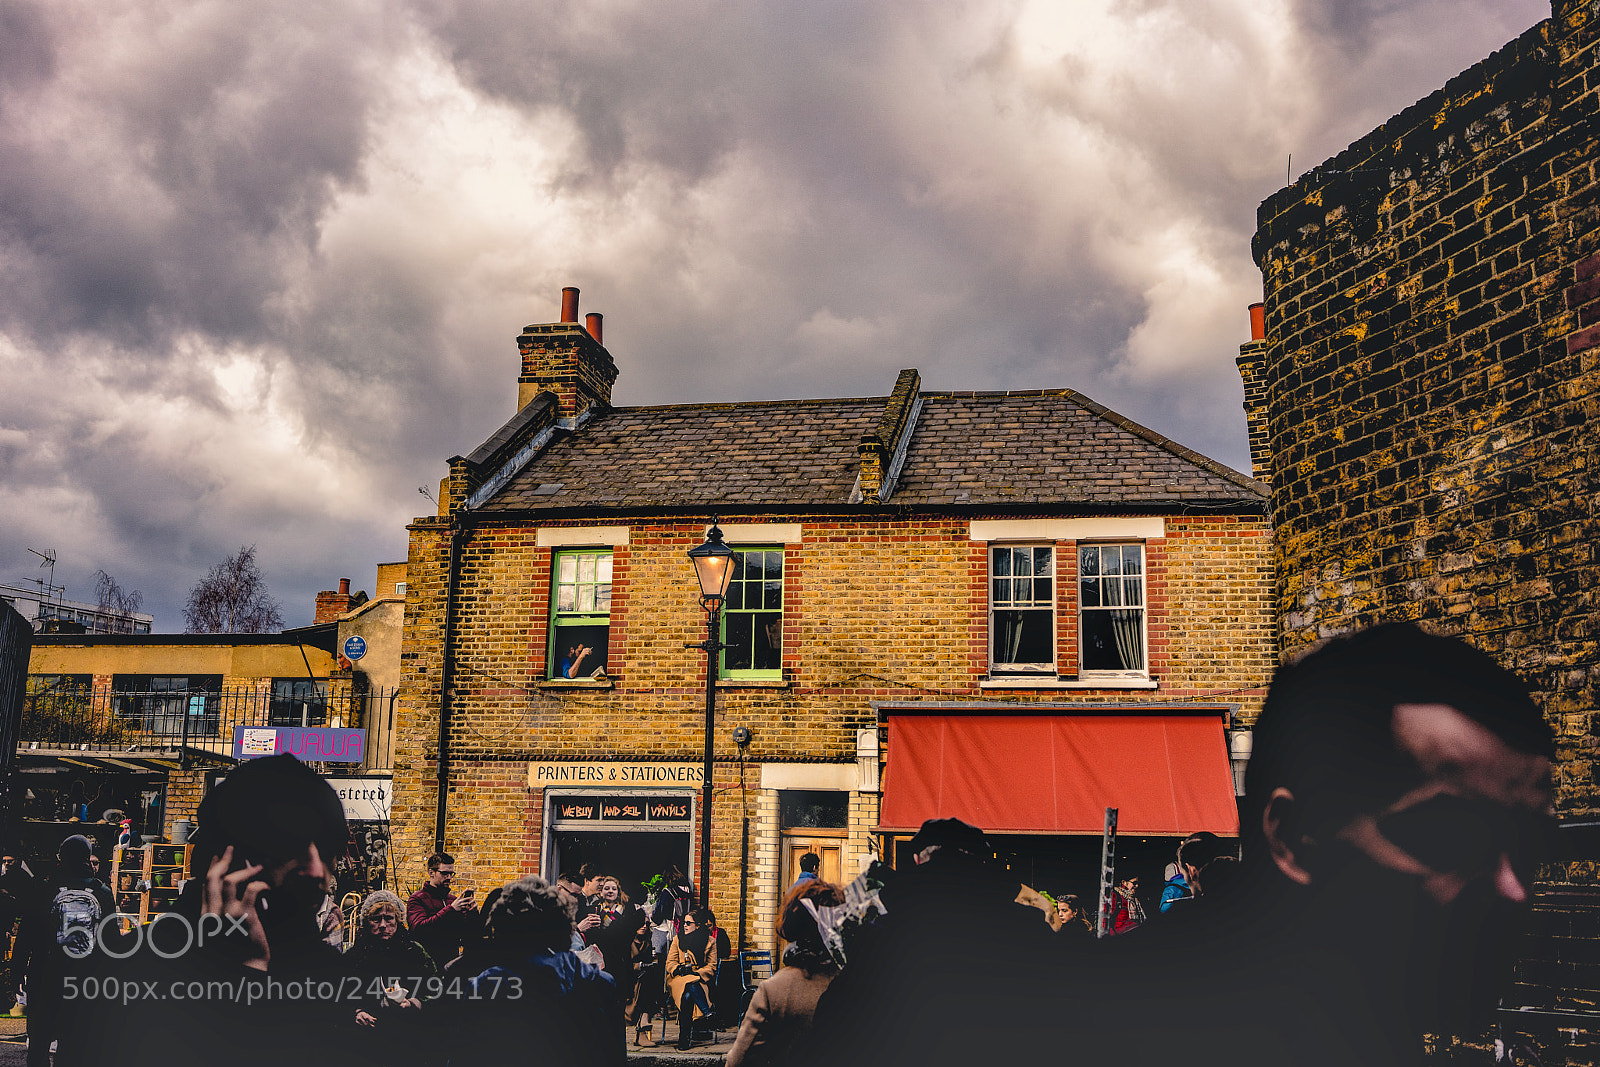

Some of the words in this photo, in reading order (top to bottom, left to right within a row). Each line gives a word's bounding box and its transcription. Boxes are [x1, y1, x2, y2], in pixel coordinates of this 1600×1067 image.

[280, 732, 362, 757] WAWA
[537, 766, 604, 780] PRINTERS
[608, 766, 618, 780] &
[621, 766, 704, 781] STATIONERS
[339, 787, 385, 800] stered
[562, 804, 575, 818] WE
[576, 806, 594, 819] BUY
[603, 806, 621, 818] AND
[622, 805, 641, 817] SELL
